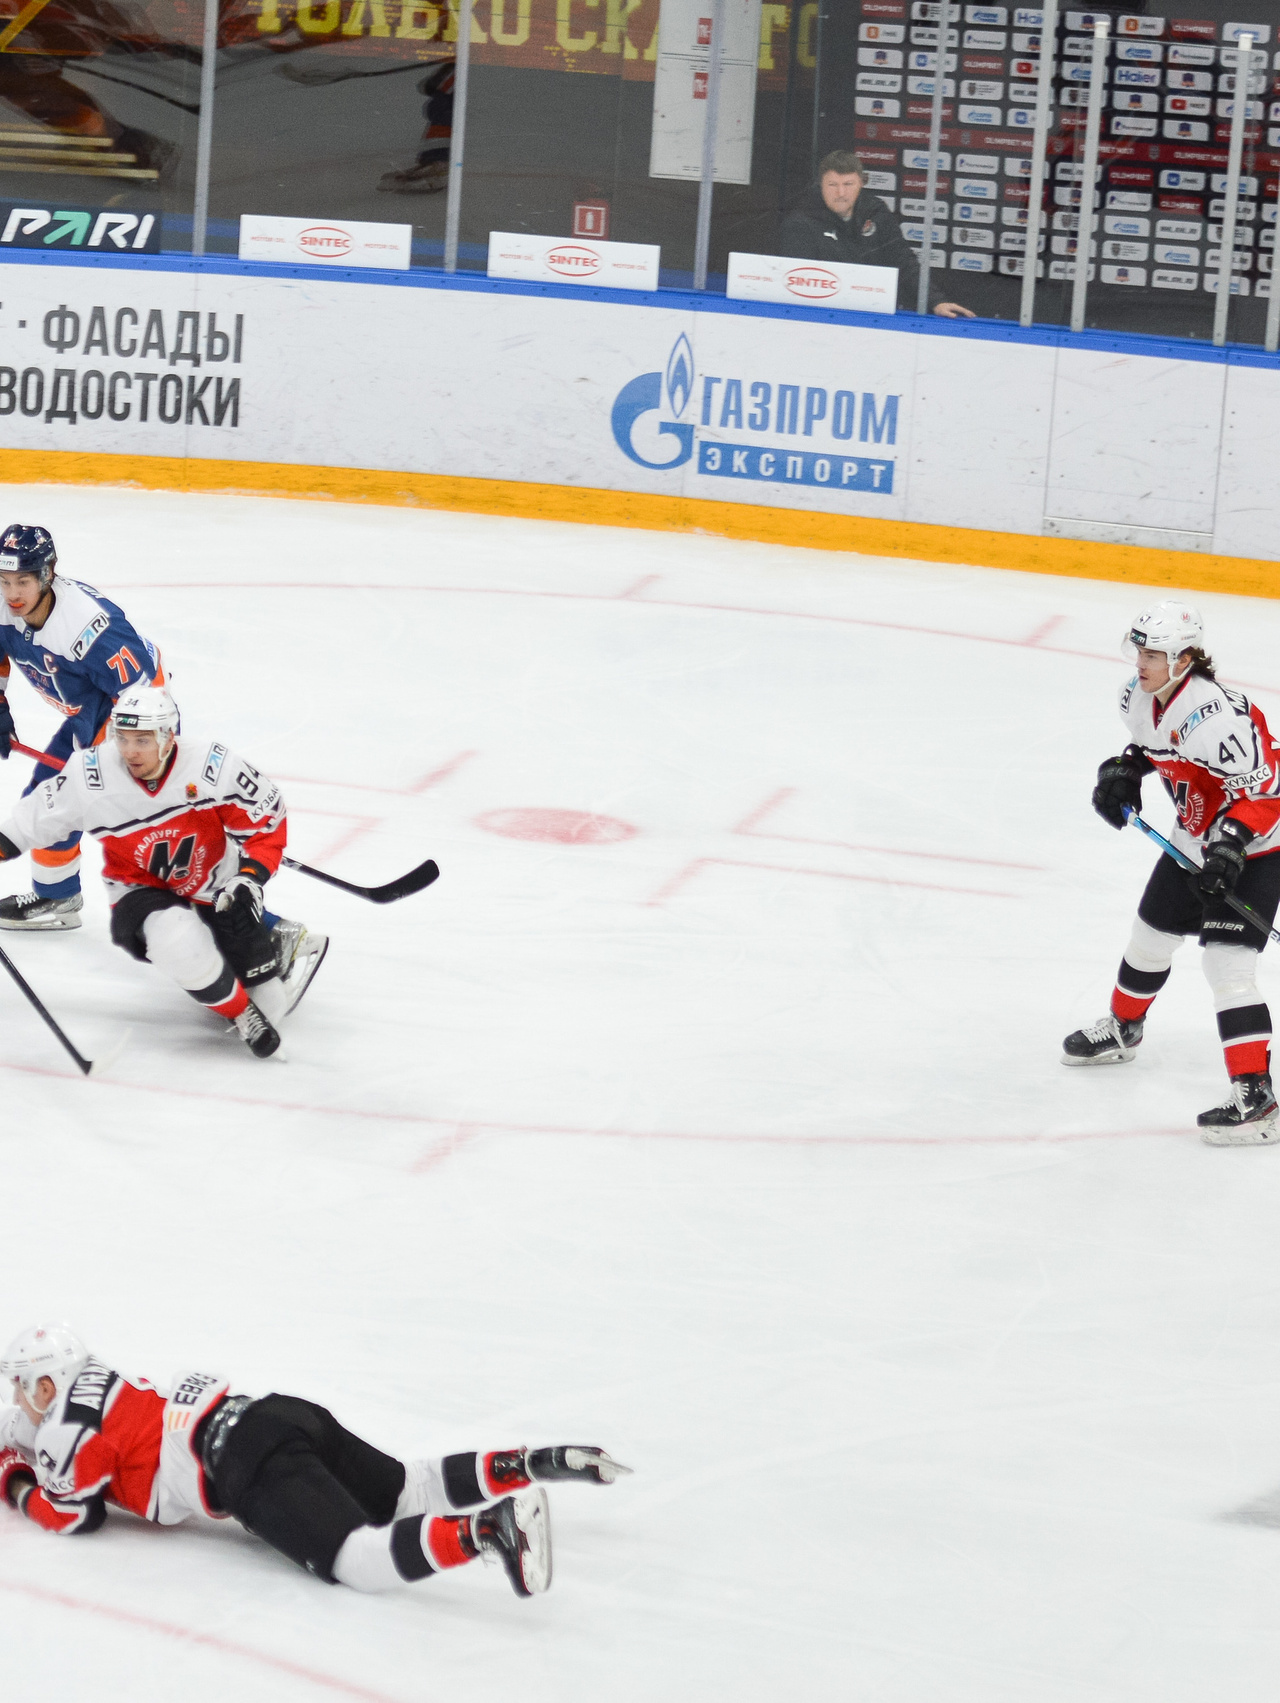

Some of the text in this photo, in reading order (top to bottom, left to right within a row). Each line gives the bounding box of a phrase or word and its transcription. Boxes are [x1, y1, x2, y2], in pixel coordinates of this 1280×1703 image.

[1118, 67, 1156, 83] Haier
[0, 208, 155, 249] PARI
[301, 236, 350, 248] SINTEC
[549, 255, 599, 267] SINTEC
[788, 276, 837, 290] SINTEC
[42, 304, 245, 367] ФАСАДЫ
[700, 376, 900, 445] ГАЗПРОМ
[705, 447, 887, 488] ЭКСПОРТ
[72, 614, 109, 657] PARI
[106, 645, 141, 684] 71
[1179, 701, 1219, 741] PARI
[1219, 733, 1247, 765] 41
[236, 760, 262, 798] 94
[1202, 921, 1245, 932] BAUER
